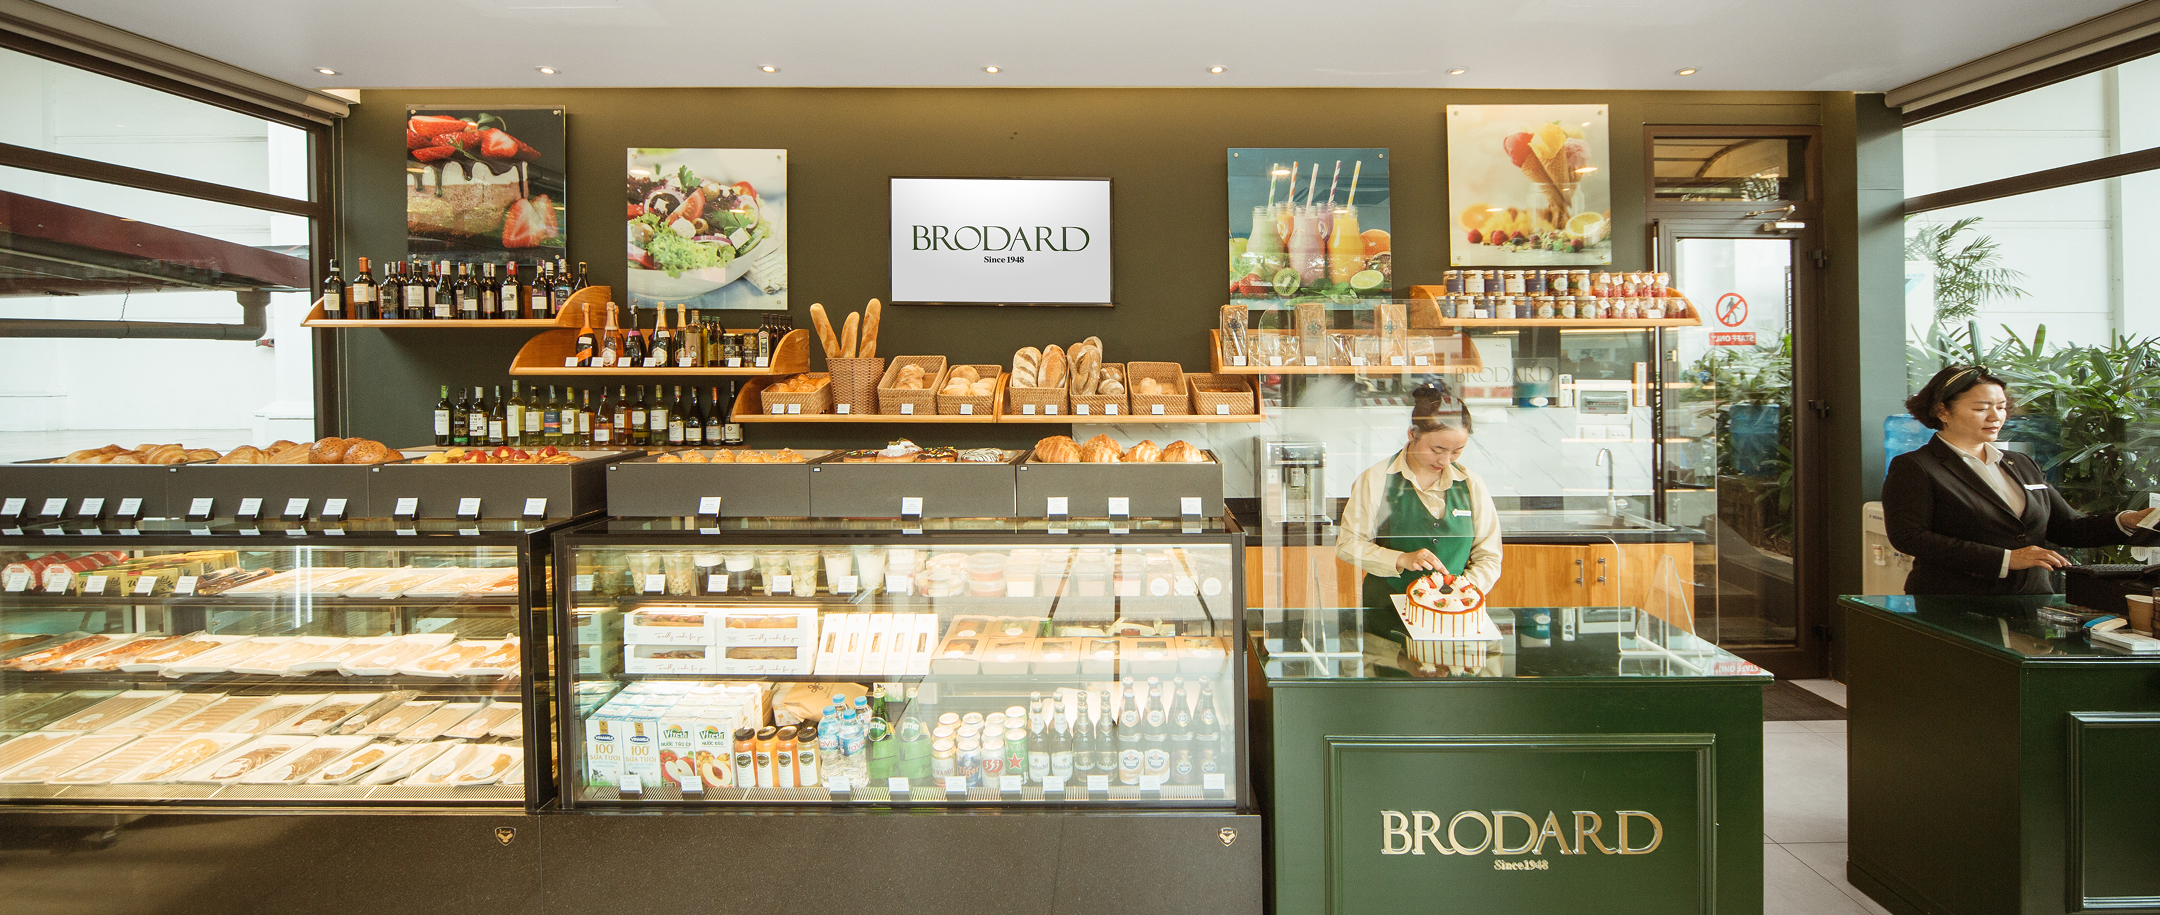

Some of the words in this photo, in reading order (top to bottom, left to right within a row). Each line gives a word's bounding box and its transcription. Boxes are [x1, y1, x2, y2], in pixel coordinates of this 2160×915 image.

[912, 225, 1090, 252] BRODARD
[983, 255, 1005, 264] Since
[1006, 256, 1025, 264] 1948
[1455, 366, 1555, 383] BRODARD
[958, 765, 980, 779] Tiger
[984, 760, 1000, 772] 333
[1380, 810, 1664, 856] BRODARD
